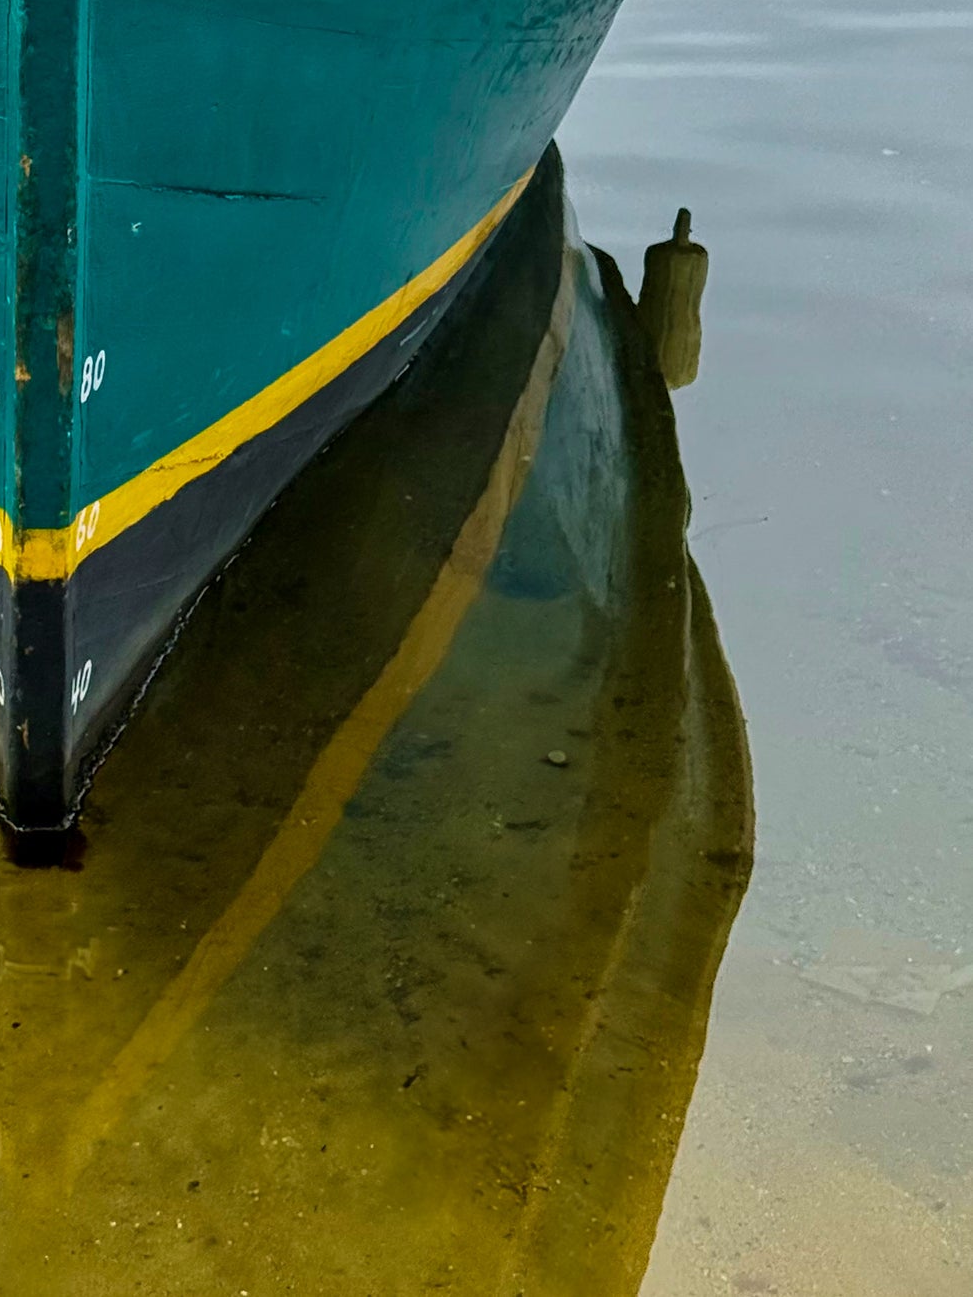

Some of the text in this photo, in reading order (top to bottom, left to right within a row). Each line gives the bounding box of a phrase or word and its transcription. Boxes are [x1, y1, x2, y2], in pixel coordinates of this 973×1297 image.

[80, 350, 106, 403] 80
[75, 500, 100, 552] 60
[70, 659, 93, 715] 40
